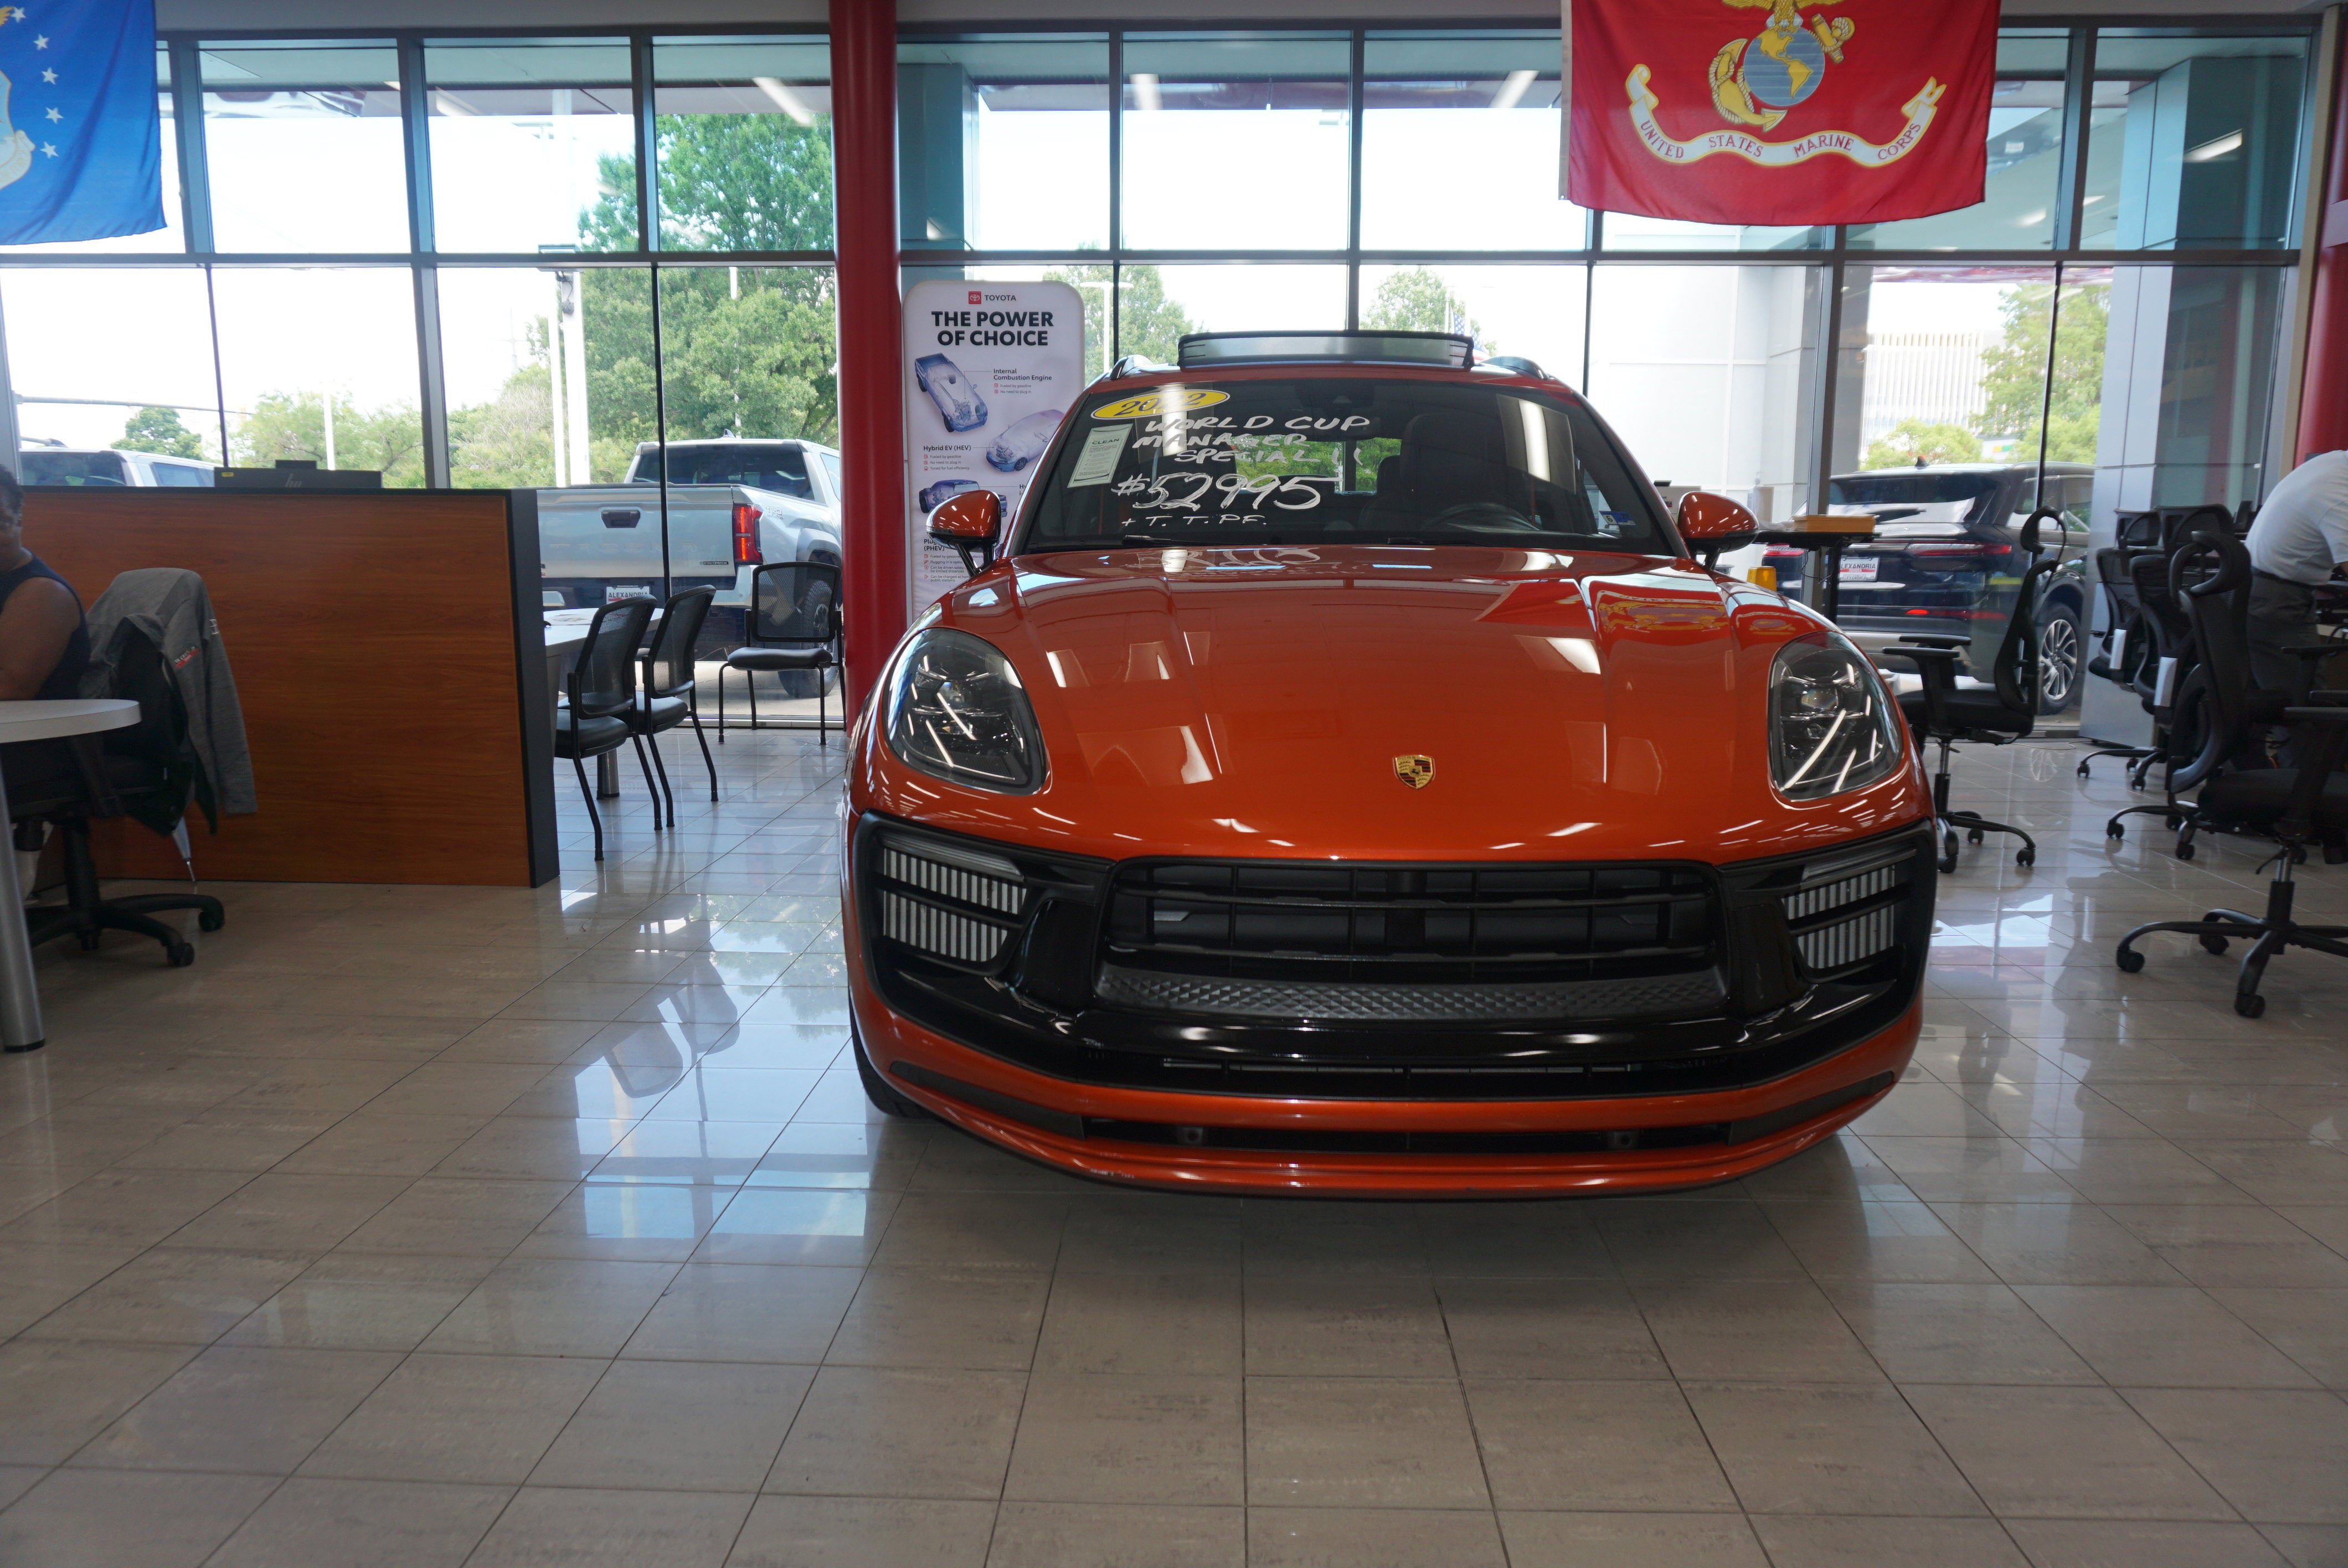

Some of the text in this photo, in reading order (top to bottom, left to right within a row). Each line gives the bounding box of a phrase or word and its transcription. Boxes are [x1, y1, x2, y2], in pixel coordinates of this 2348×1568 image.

[1640, 120, 1921, 160] UNITED STATES MARINE CORPS
[931, 311, 1054, 327] THE POWER
[938, 331, 1048, 345] OF CHOICE
[1145, 416, 1370, 433] WORLD CUP
[1131, 433, 1310, 449] MANAGER
[1173, 448, 1321, 464] SPECIAL
[1111, 472, 1343, 511] $52995
